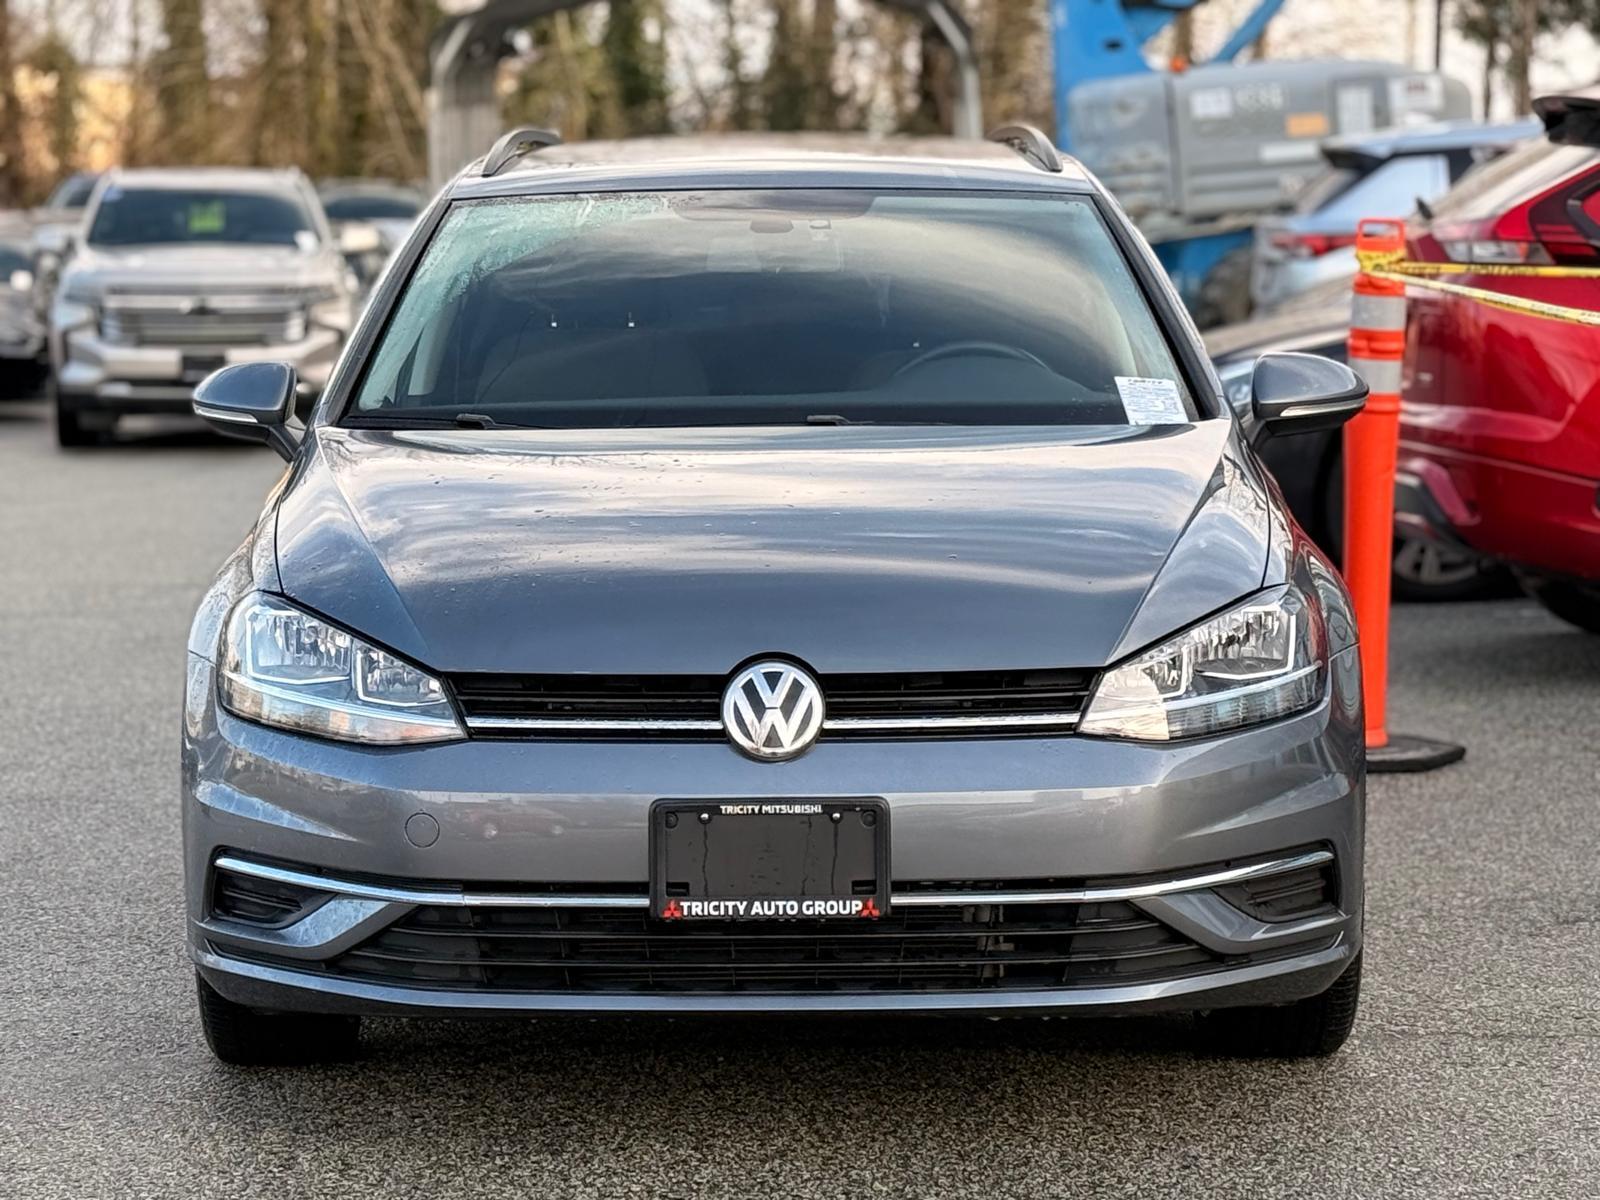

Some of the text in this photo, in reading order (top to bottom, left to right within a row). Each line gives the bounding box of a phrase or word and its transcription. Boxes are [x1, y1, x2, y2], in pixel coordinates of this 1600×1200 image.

[720, 805, 823, 814] TRICITY MITSUBISHI
[680, 900, 863, 916] TRICITY AUTO GROUP
